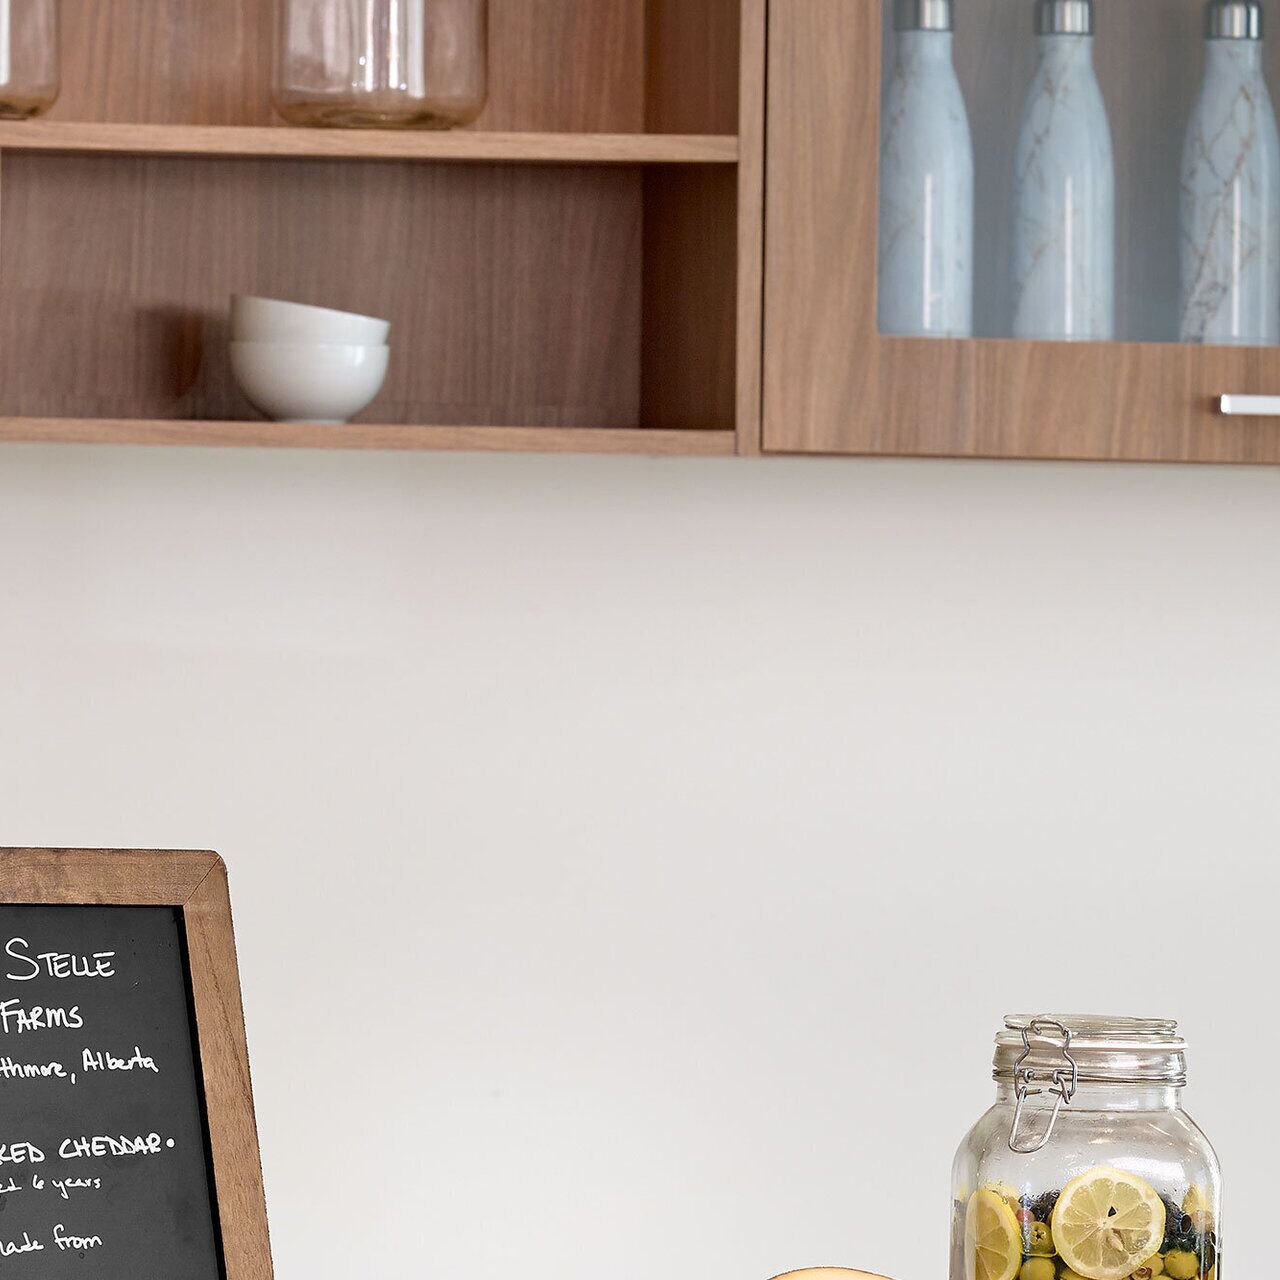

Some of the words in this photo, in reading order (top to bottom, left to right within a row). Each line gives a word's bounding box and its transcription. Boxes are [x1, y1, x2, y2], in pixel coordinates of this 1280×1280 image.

[4, 937, 116, 981] STELLE
[81, 1045, 160, 1073] Alberta
[58, 1132, 162, 1159] CHEDDAR
[31, 1174, 45, 1190] 6
[52, 1176, 102, 1200] years
[53, 1223, 103, 1251] from
